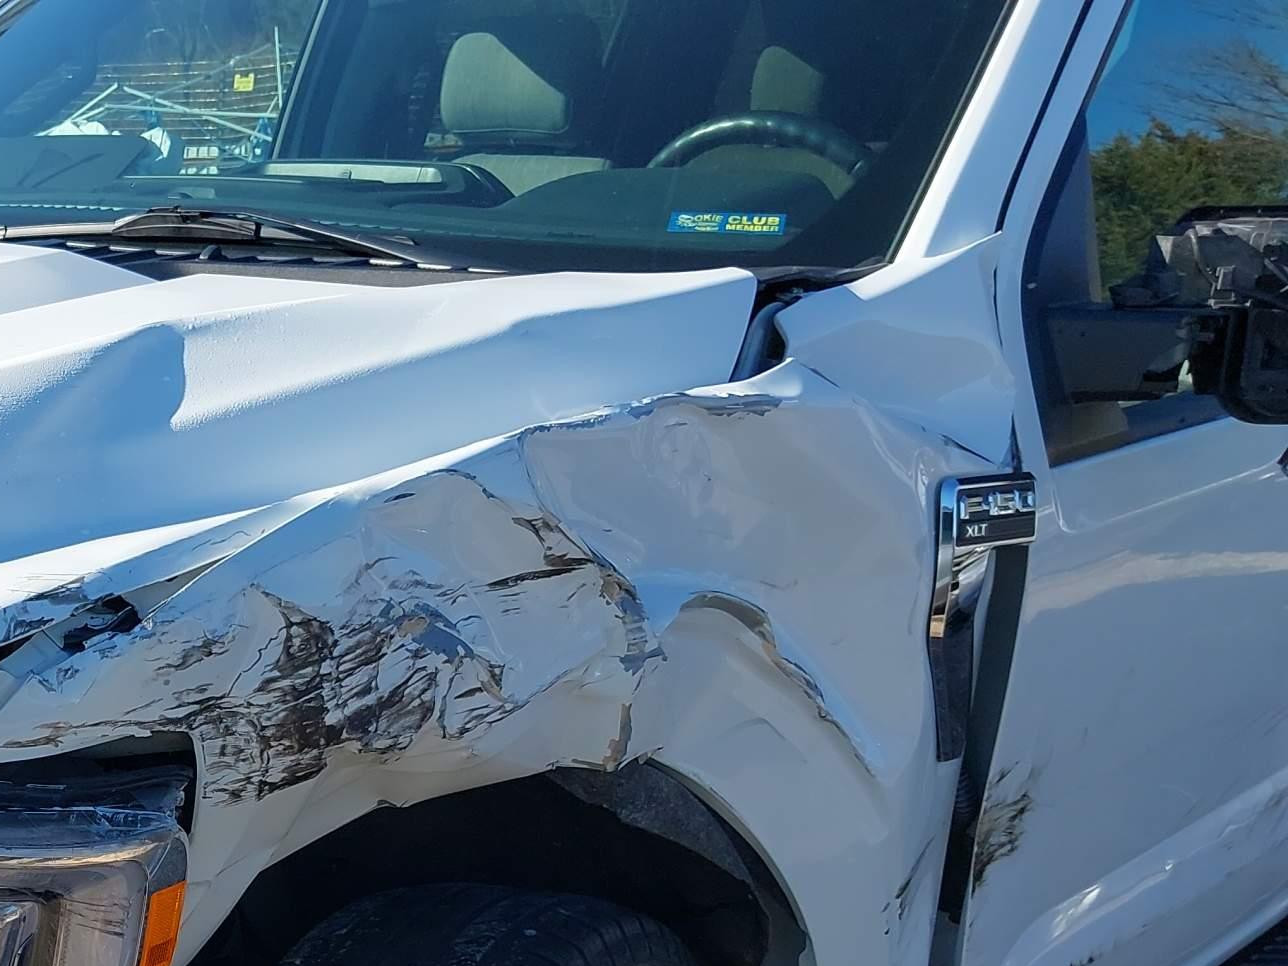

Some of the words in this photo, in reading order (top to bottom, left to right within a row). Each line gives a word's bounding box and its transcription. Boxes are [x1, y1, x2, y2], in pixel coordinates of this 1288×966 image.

[727, 215, 780, 226] CLUB
[725, 224, 779, 232] MEMBER
[965, 523, 988, 538] XLT
